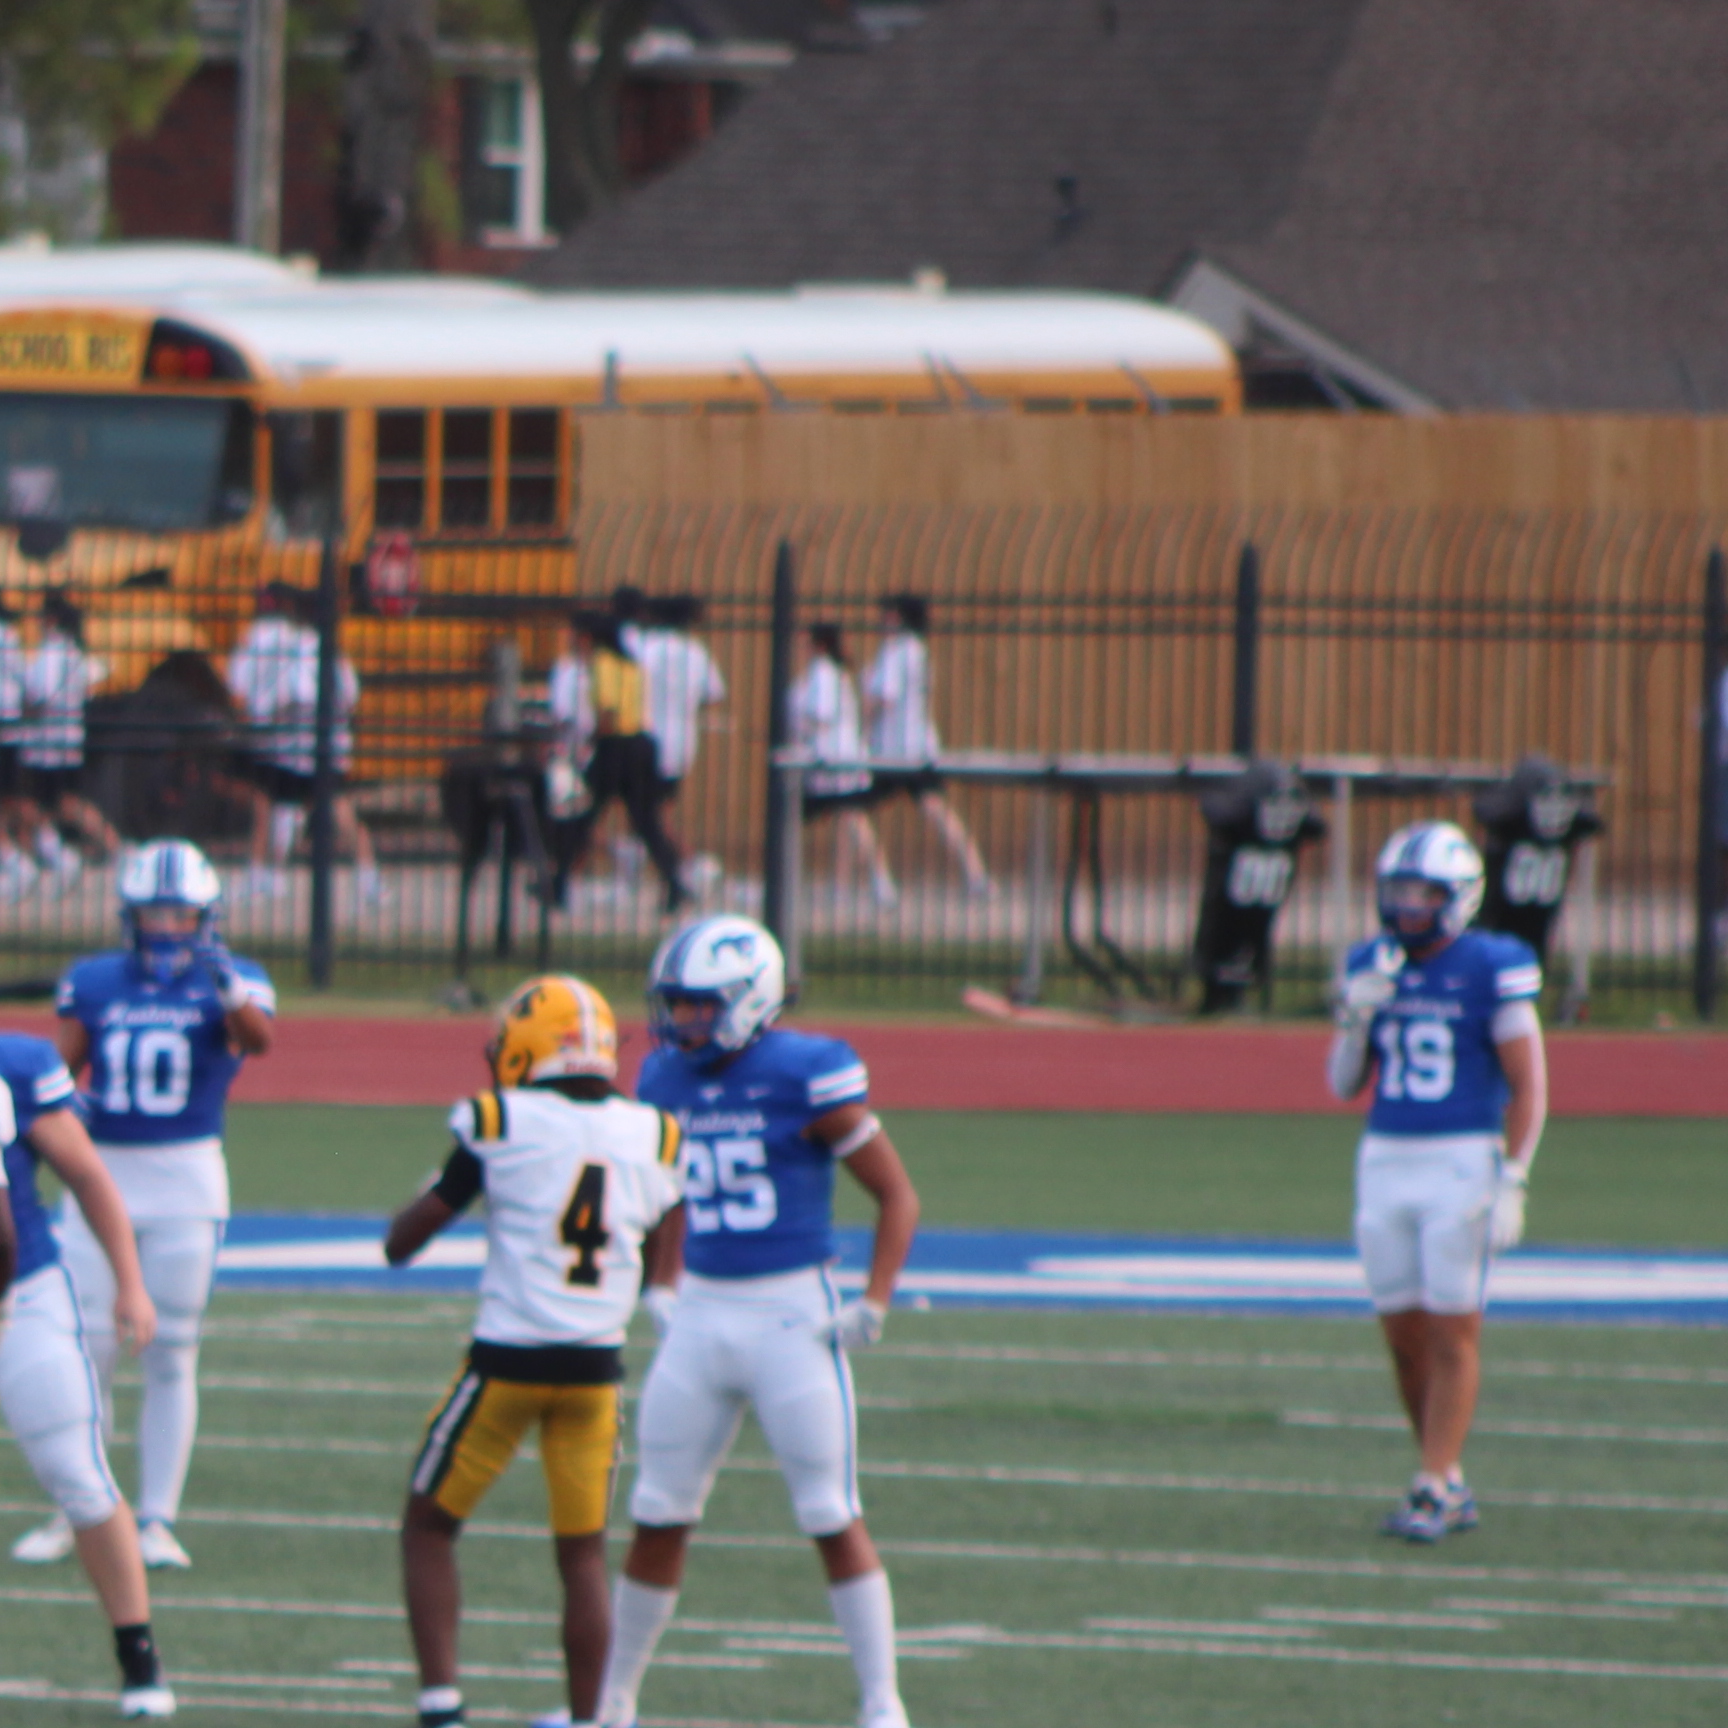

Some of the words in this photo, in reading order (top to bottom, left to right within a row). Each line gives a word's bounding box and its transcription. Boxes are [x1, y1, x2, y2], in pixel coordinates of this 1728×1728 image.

[88, 335, 132, 371] BUS
[104, 1029, 192, 1117] 10
[1379, 1020, 1455, 1101] 19
[559, 1162, 610, 1286] 4
